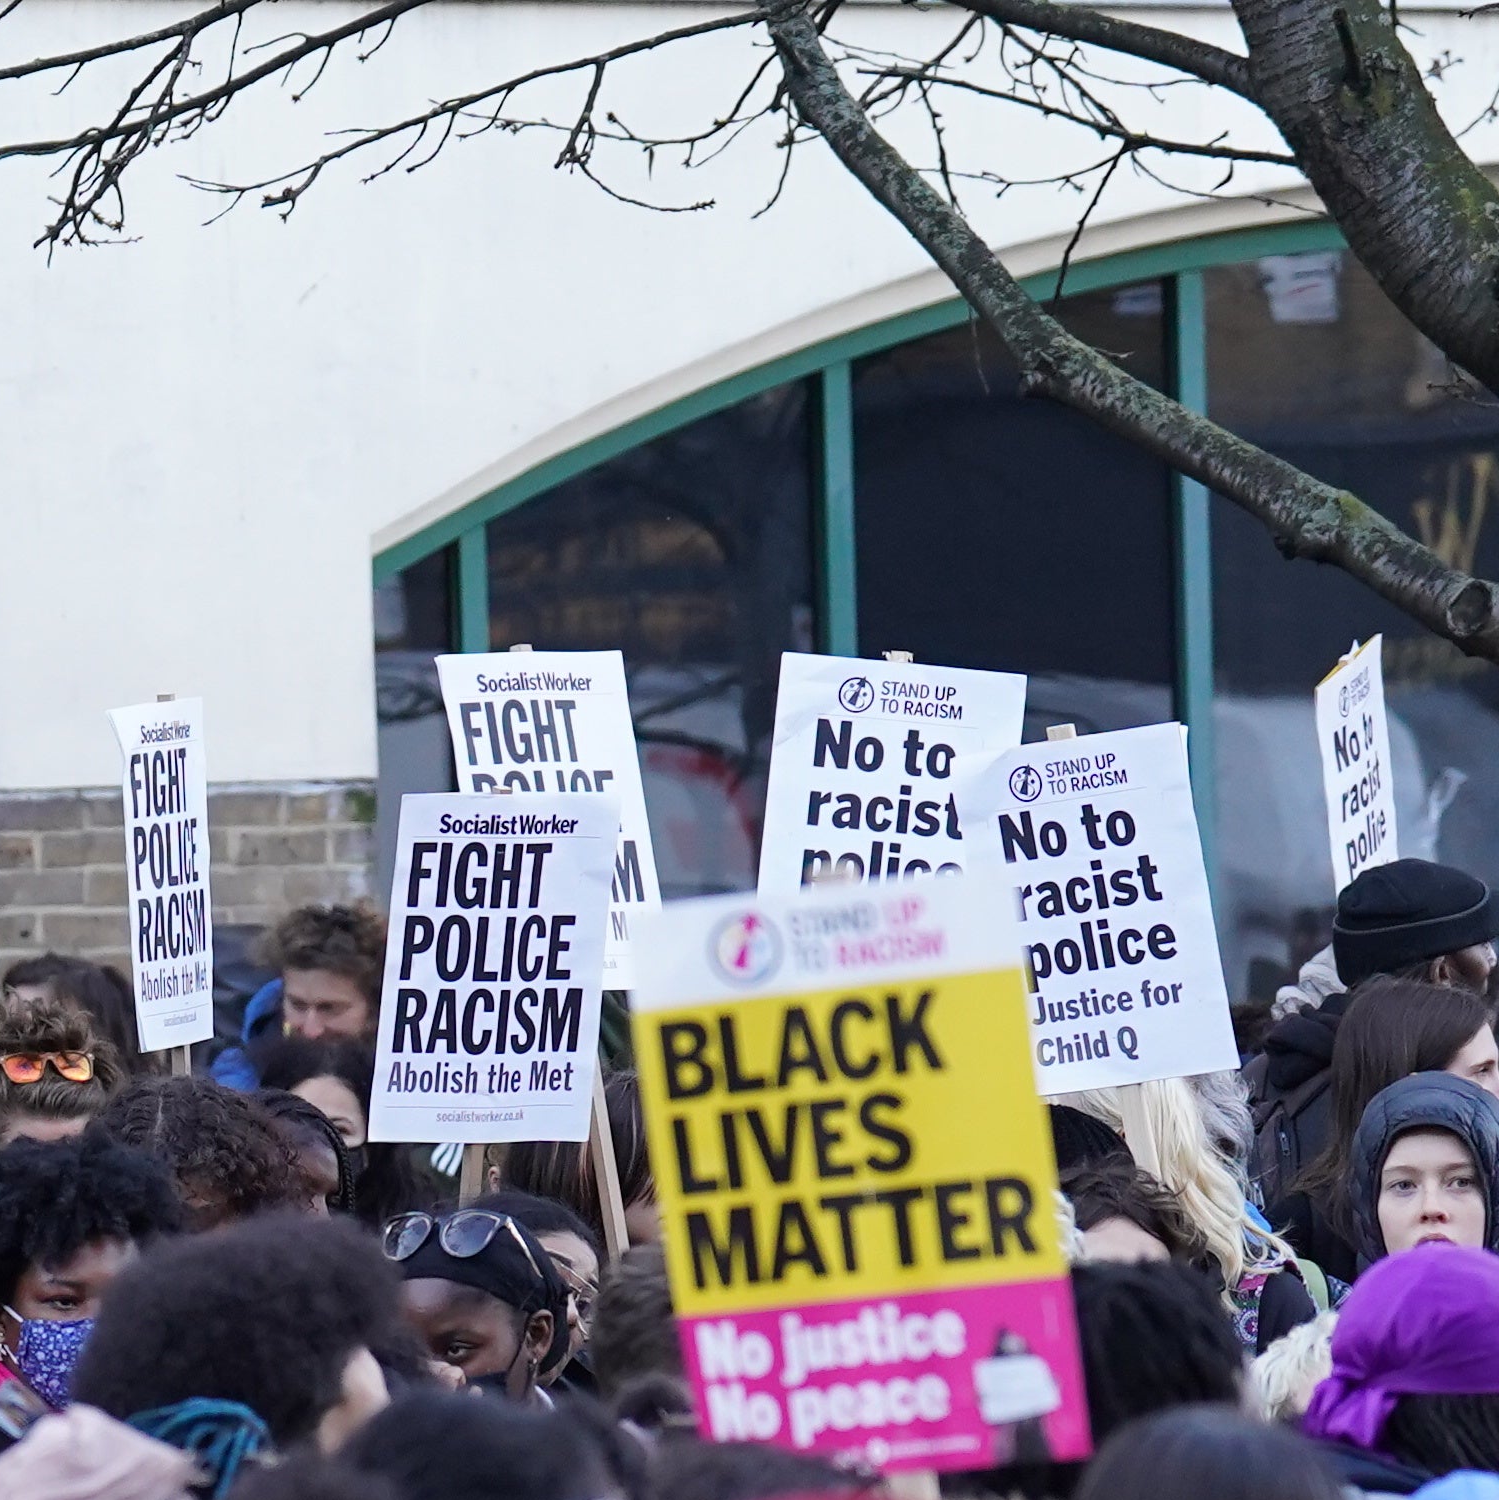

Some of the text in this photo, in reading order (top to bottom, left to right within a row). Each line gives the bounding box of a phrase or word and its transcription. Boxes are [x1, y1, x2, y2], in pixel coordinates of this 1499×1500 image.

[880, 698, 963, 720] TO RACISM
[881, 680, 956, 701] STAND UP
[459, 699, 578, 766] FIGHT
[813, 718, 956, 779] No to
[1044, 753, 1116, 778] STAND UP
[1333, 712, 1373, 772] No to
[130, 748, 187, 818] FIGHT
[806, 784, 963, 840] racist
[1048, 769, 1128, 796] TO RACISM
[1342, 751, 1381, 823] racist
[133, 818, 198, 891] POLICE
[998, 803, 1136, 863] No to
[406, 841, 553, 910] FIGHT
[1015, 854, 1163, 922] racist
[138, 888, 206, 963] RACISM
[399, 914, 576, 982] POLICE
[1023, 918, 1177, 993] police
[141, 961, 208, 1003] Abolish the Met
[1032, 979, 1183, 1025] Justice for
[391, 987, 583, 1055] RACISM
[659, 990, 944, 1100] BLACK
[1036, 1025, 1139, 1067] Child Q
[387, 1060, 574, 1094] Abolish the Met
[672, 1093, 914, 1195] LIVES
[686, 1176, 1037, 1290] MATTER
[694, 1301, 966, 1388] No justice
[706, 1372, 951, 1448] No peace
